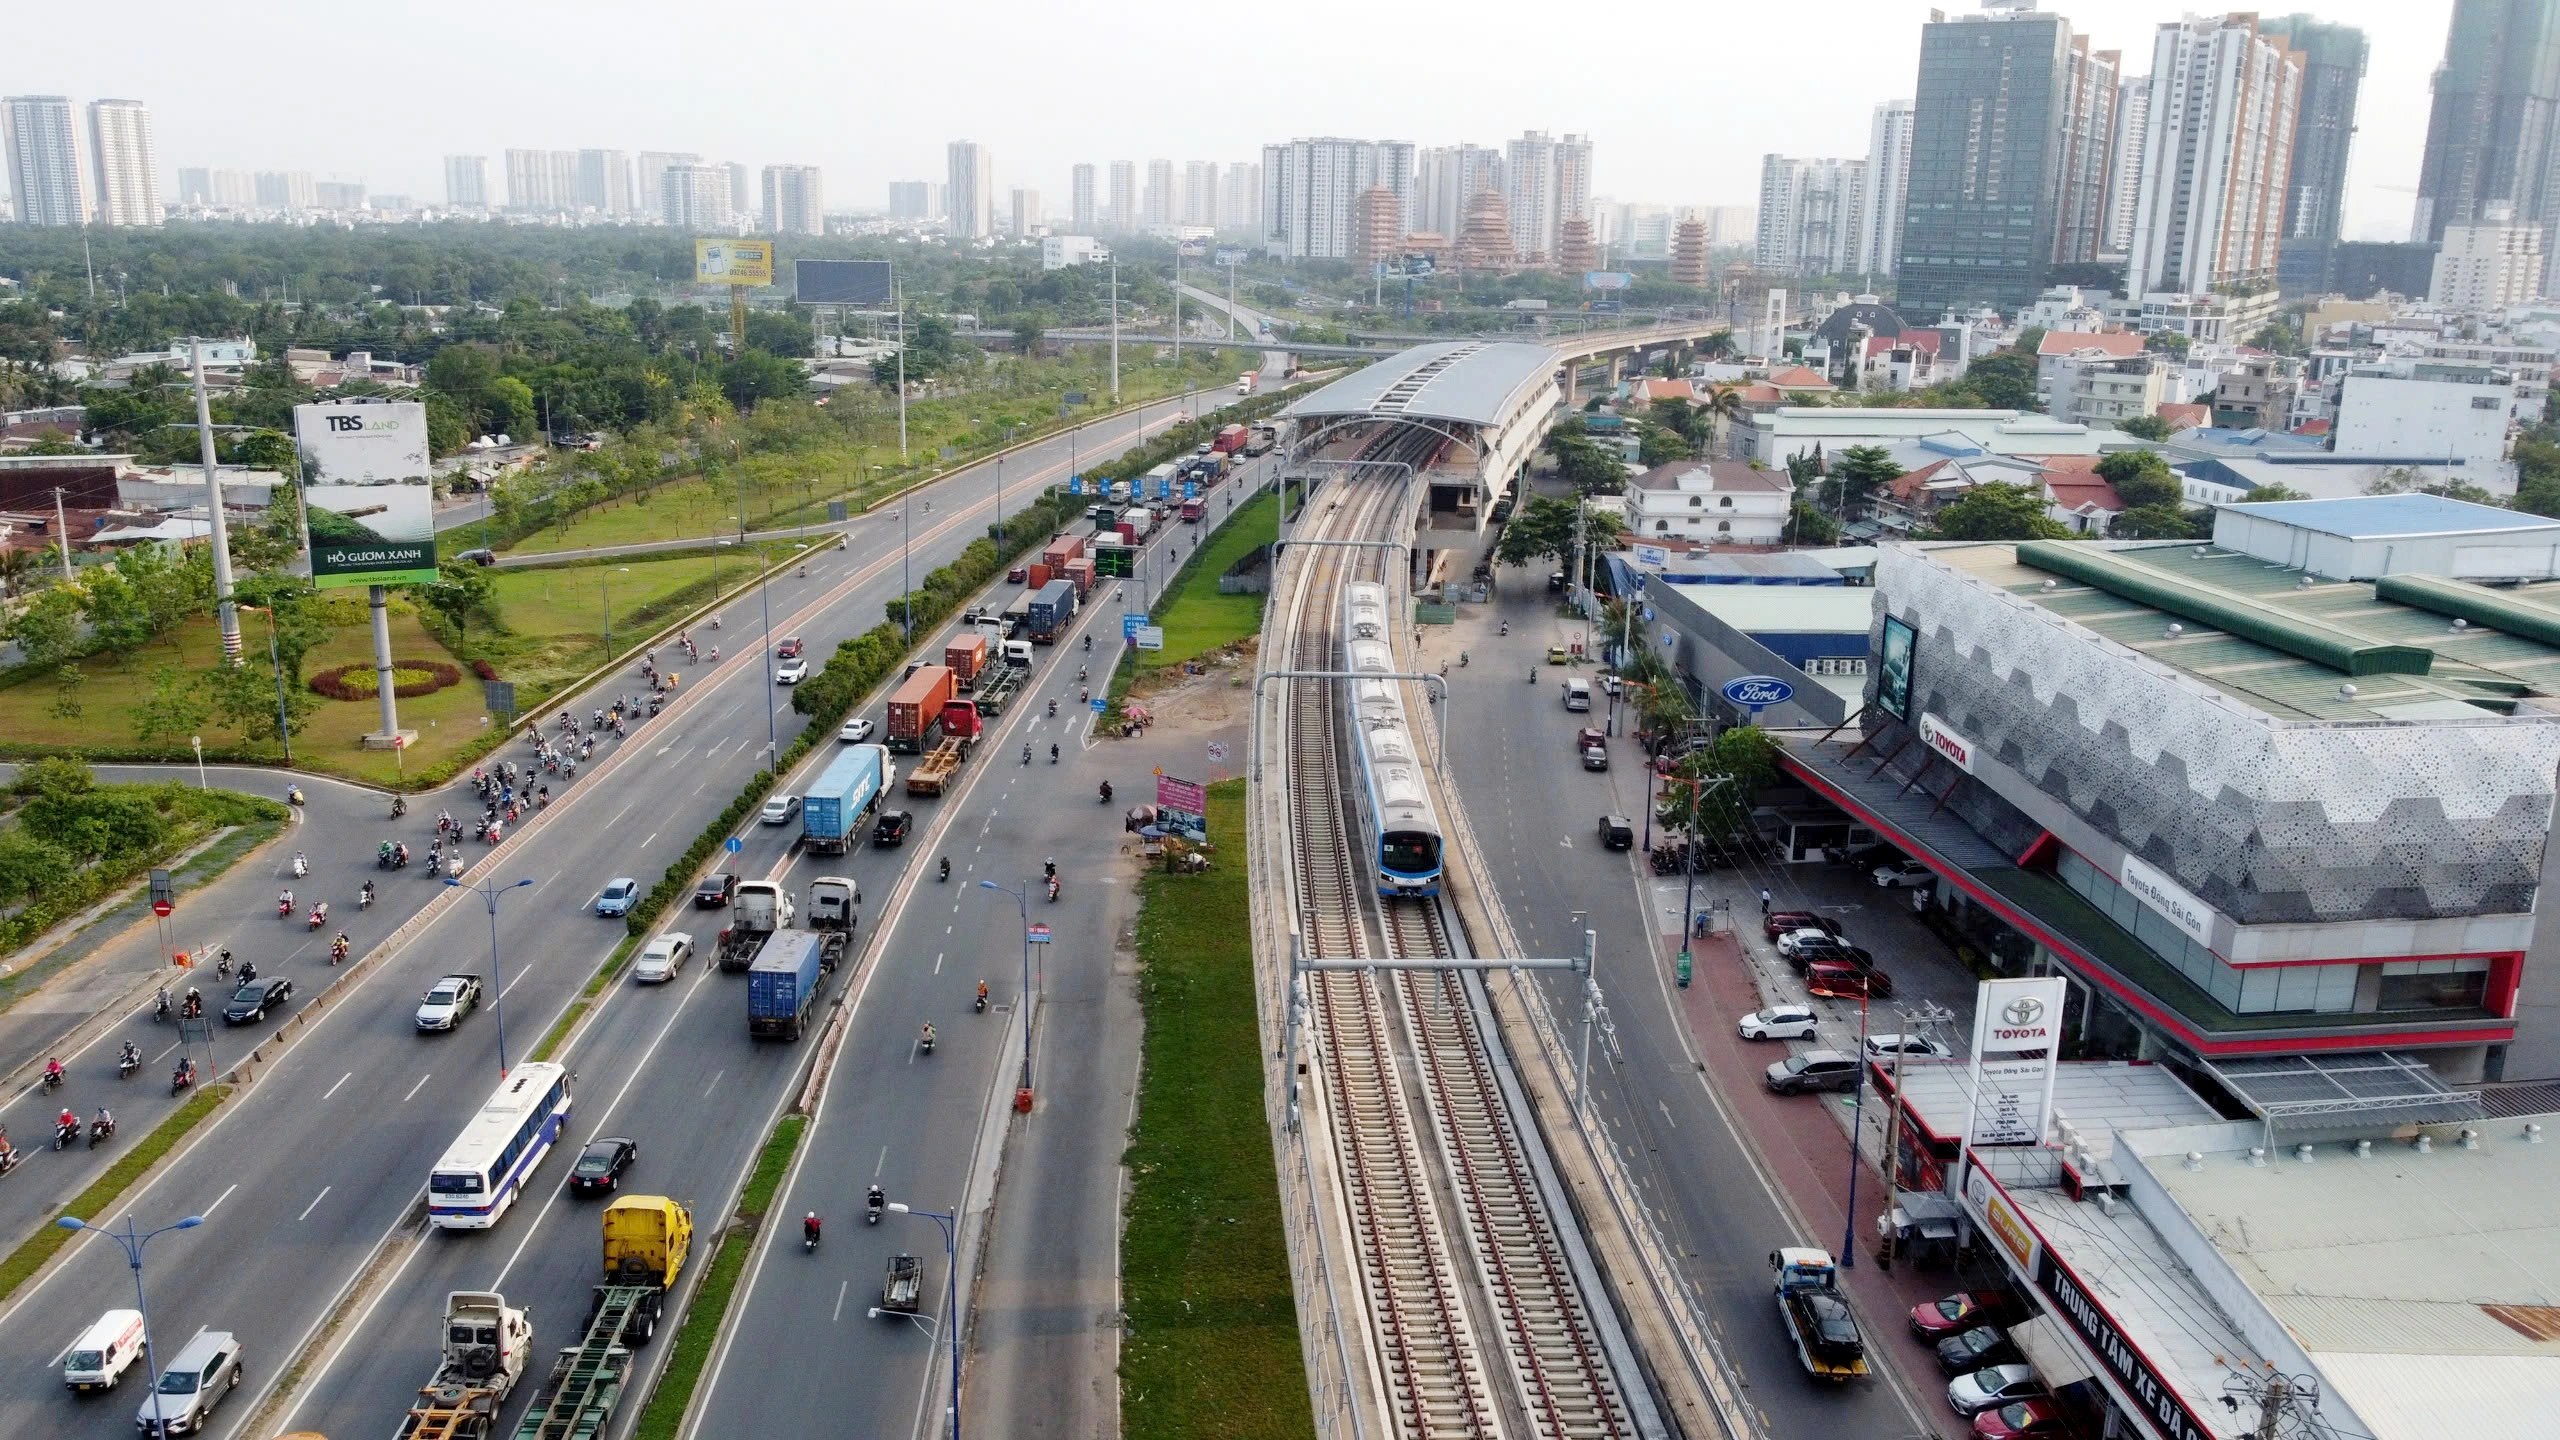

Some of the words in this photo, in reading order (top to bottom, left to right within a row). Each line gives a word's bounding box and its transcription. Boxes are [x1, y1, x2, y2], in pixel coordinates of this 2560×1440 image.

[326, 415, 363, 431] TBS
[364, 420, 399, 431] LAND
[327, 550, 346, 563] HỒ
[388, 549, 421, 560] XANH
[1738, 682, 1782, 701] Ford
[1935, 730, 1966, 765] TOYOTA
[2127, 868, 2149, 896] Toyota
[2150, 885, 2170, 912] Đông
[1994, 1028, 2047, 1040] TOYOTA
[2054, 1268, 2099, 1338] TRUNG
[2101, 1324, 2134, 1380] TÂM
[2135, 1366, 2157, 1408] XE
[2159, 1395, 2182, 1439] ĐÃ
